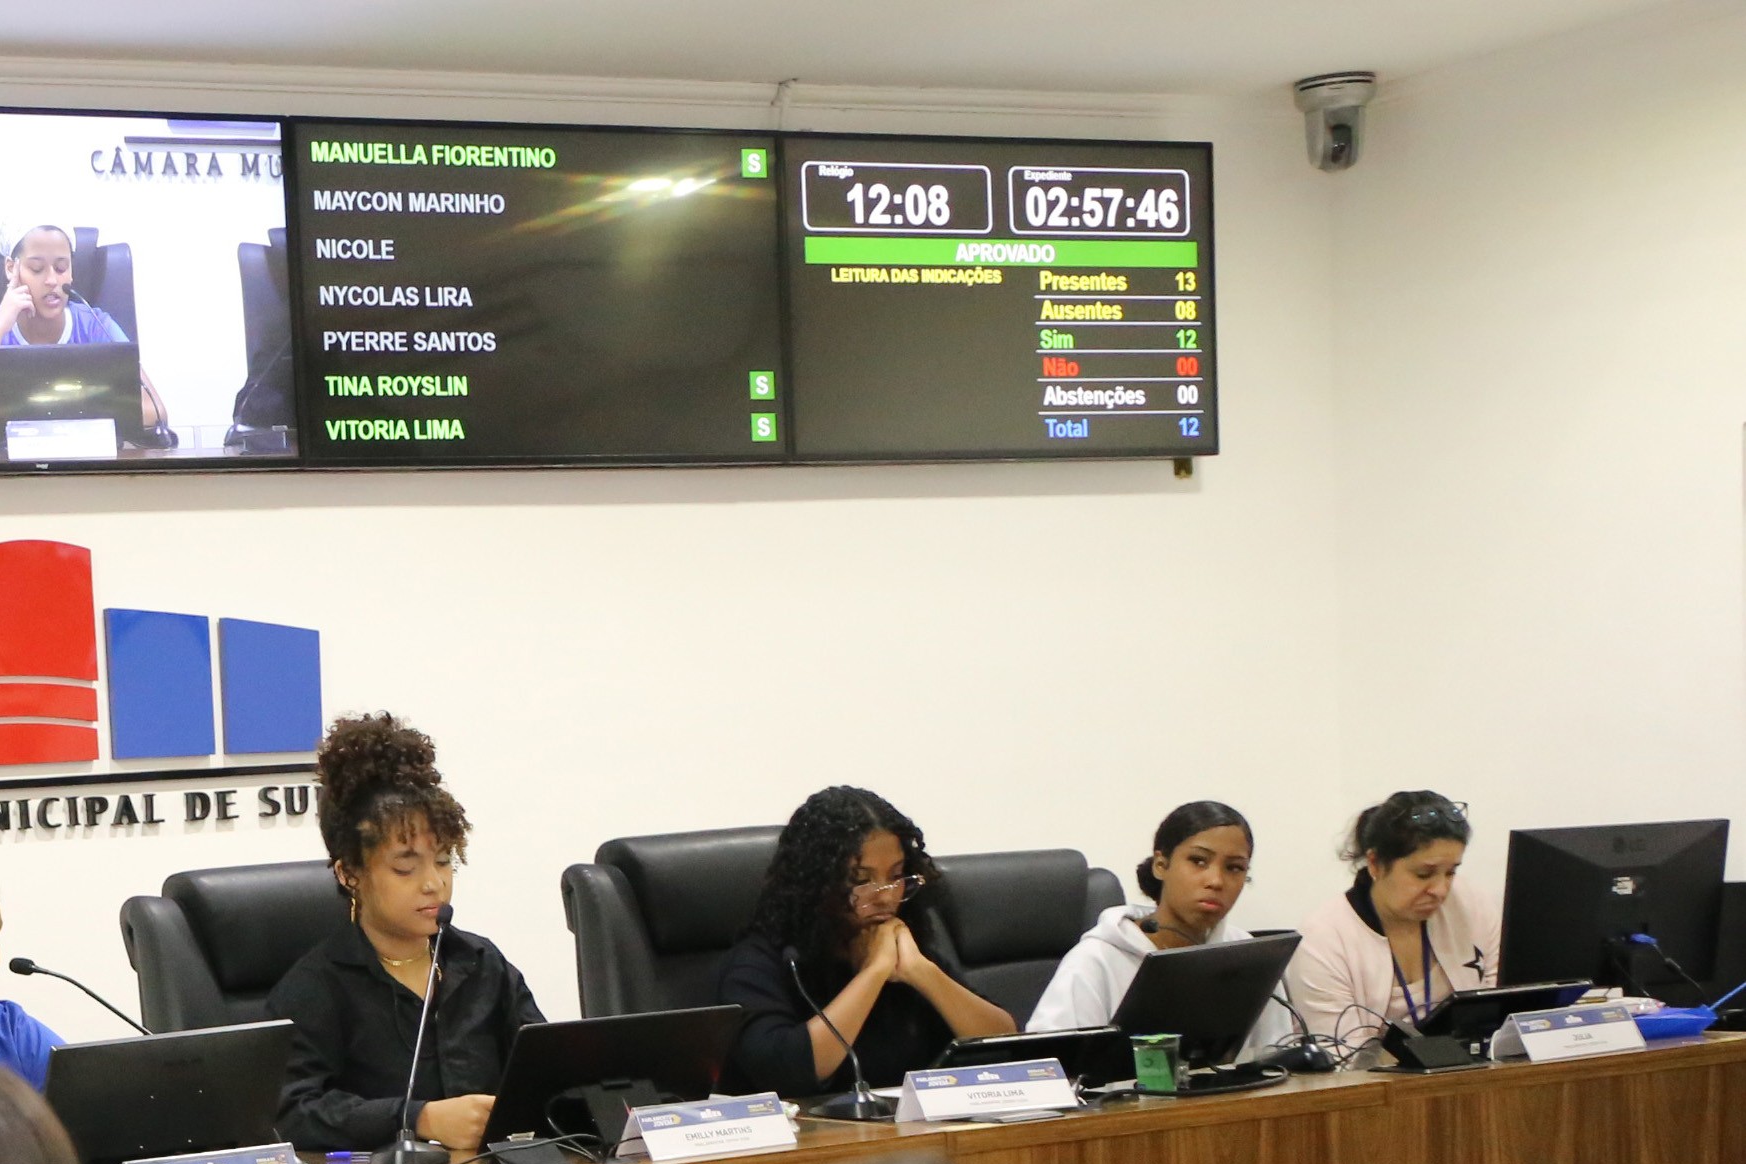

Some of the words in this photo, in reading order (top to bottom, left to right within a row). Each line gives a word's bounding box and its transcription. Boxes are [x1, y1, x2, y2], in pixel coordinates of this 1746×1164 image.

[91, 146, 223, 177] CÂMARA
[311, 141, 428, 165] MANUELLA
[432, 145, 556, 168] FIORENTINO
[748, 154, 761, 173] S
[819, 165, 853, 178] Relógio
[1024, 170, 1072, 182] Expediente
[314, 190, 402, 212] MAYCON
[409, 192, 505, 214] MARINHO
[847, 183, 950, 226] 12:08
[1025, 186, 1179, 228] 02:57:46
[316, 239, 394, 260] NICOLE
[955, 244, 1055, 263] APROVADO
[832, 268, 890, 284] LEITURA
[892, 268, 918, 284] DAS
[922, 267, 1002, 286] INDICAÇÕES
[1039, 270, 1128, 291] Presentes
[1175, 271, 1196, 291] 13
[320, 286, 419, 306] NYCOLAS
[425, 287, 473, 306] LIRA
[1040, 300, 1123, 320] Ausentes
[1175, 301, 1196, 320] 08
[324, 332, 408, 351] PYERRE
[414, 332, 496, 351] SANTOS
[1040, 330, 1073, 349] Sim
[1176, 329, 1196, 348] 12
[1043, 356, 1079, 377] Não
[1177, 357, 1198, 376] 00
[325, 376, 373, 396] TINA
[378, 376, 467, 396] ROYSLIN
[756, 376, 768, 395] S
[1043, 385, 1146, 409] Abstenções
[1177, 385, 1198, 404] 00
[326, 420, 410, 440] VITORIA
[414, 420, 465, 439] LIMA
[757, 417, 770, 437] S
[1044, 418, 1090, 439] Total
[1178, 417, 1201, 438] 12
[184, 790, 239, 821] DE
[258, 785, 323, 817] SU
[967, 1092, 1002, 1100] VITORIA
[1004, 1089, 1024, 1097] LIMA
[685, 1130, 714, 1141] EMILLY
[716, 1126, 752, 1138] MARTINS
